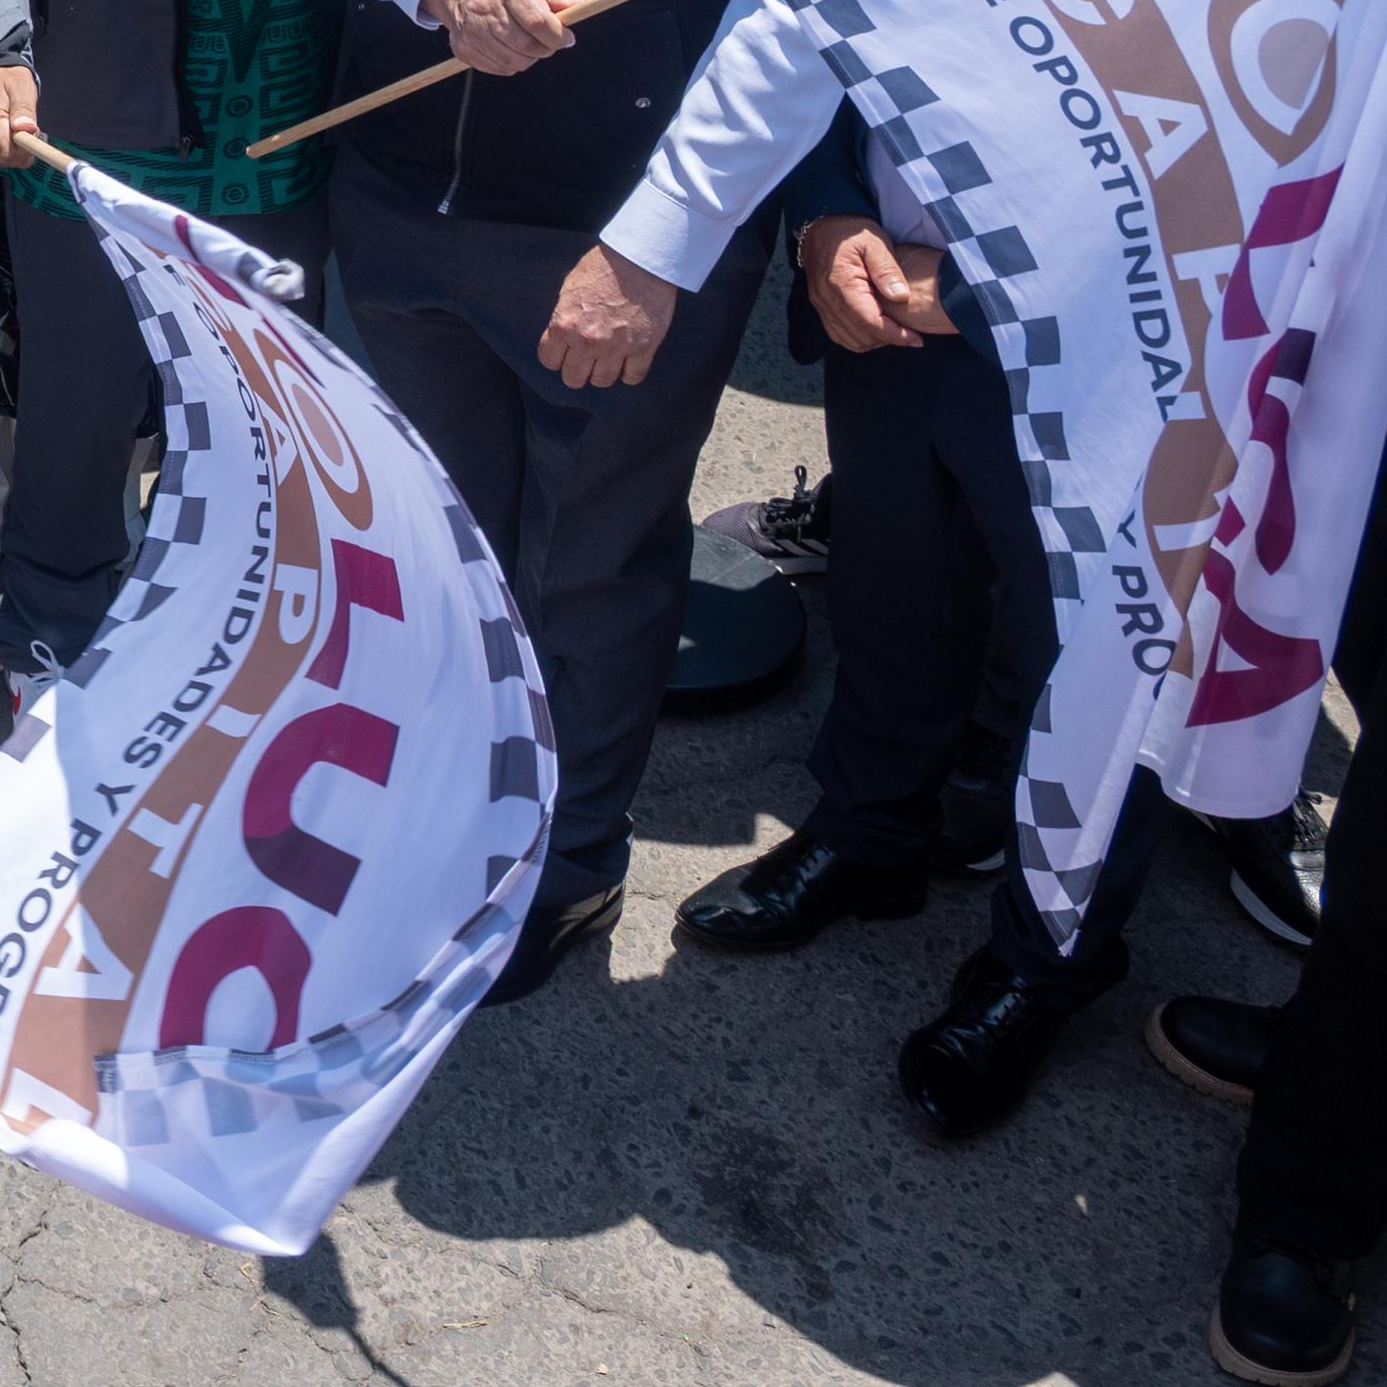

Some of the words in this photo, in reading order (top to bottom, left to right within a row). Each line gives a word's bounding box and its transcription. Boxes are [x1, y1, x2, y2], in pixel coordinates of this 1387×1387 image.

[122, 301, 274, 770] OPORTUNIDADES
[1111, 563, 1176, 701] PRO
[93, 781, 137, 814] Y
